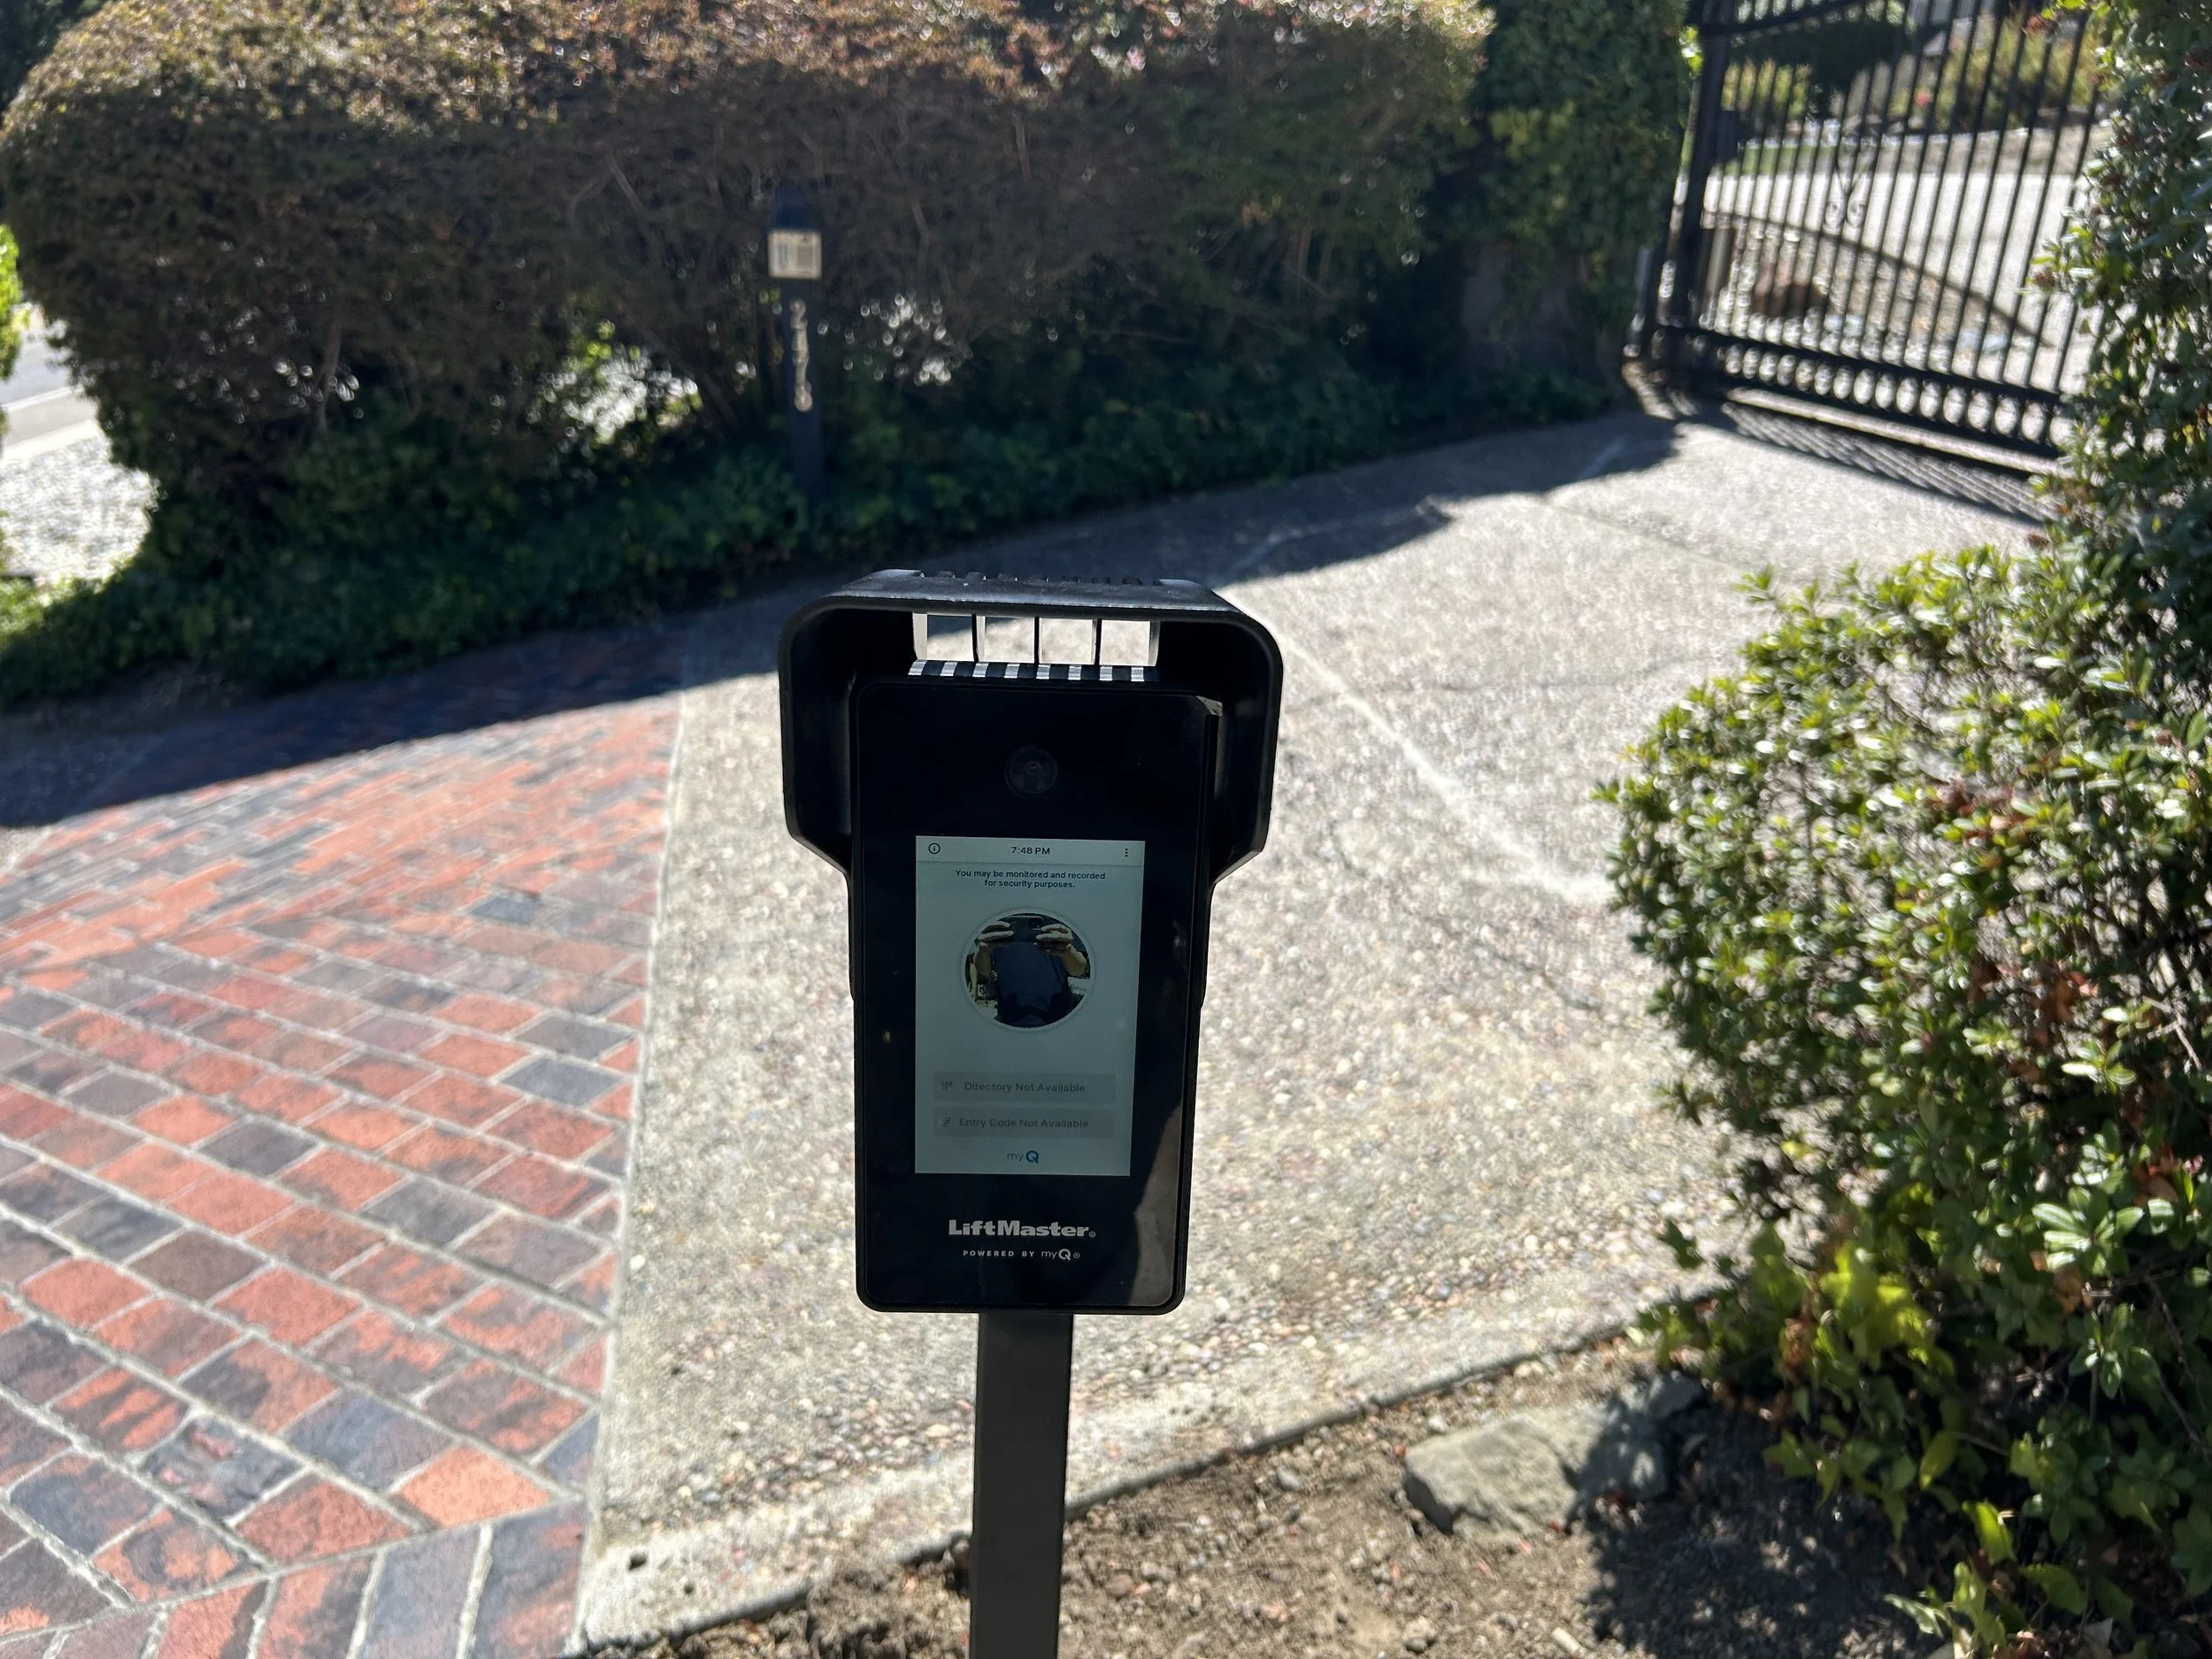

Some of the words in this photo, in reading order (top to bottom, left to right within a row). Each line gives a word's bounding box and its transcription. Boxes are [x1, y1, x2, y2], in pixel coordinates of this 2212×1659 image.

[1011, 846, 1033, 855] 7:48
[1035, 847, 1050, 856] PM
[956, 869, 972, 878] You
[994, 870, 1003, 879] be
[1006, 870, 1048, 879] monitored
[1068, 872, 1105, 880] recorded
[999, 879, 1032, 889] security
[1033, 880, 1075, 890] purposes.
[964, 1082, 1012, 1093] Directory
[1016, 1083, 1034, 1093] Not
[1037, 1083, 1086, 1094] Available
[959, 1118, 987, 1129] Entry
[989, 1118, 1017, 1128] Code
[1019, 1118, 1038, 1128] Not
[1041, 1118, 1089, 1129] Available
[949, 1219, 1089, 1237] LiftMaster
